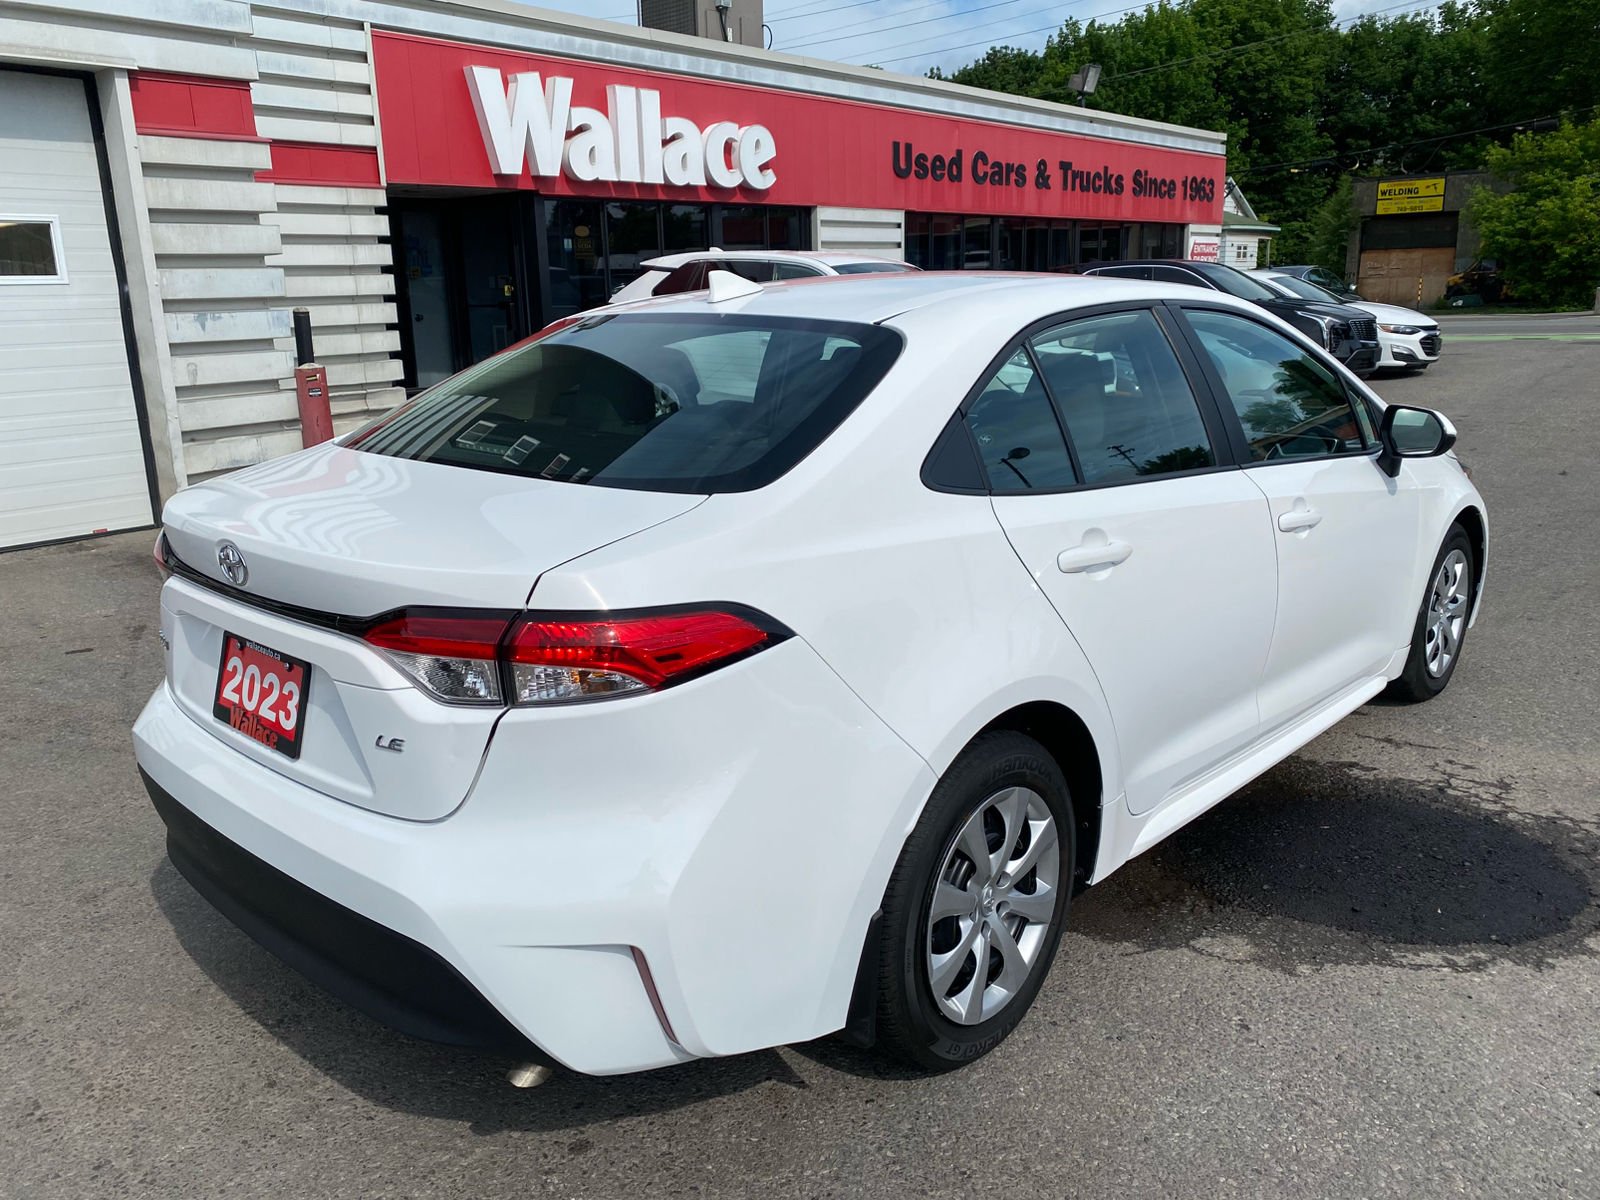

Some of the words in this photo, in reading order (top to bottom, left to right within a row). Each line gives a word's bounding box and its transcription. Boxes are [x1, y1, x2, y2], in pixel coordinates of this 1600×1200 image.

[463, 65, 777, 190] Wallace
[892, 141, 963, 183] Used
[971, 150, 1027, 188] Cars
[1035, 158, 1051, 190] &
[1059, 160, 1124, 196] Trucks
[1132, 168, 1176, 199] Since
[1181, 175, 1215, 203] 1963
[1380, 187, 1419, 197] WELDING
[1193, 244, 1218, 253] ENTRANCE
[245, 640, 281, 661] wallaceauto.ca
[222, 656, 300, 731] 2023
[229, 703, 278, 750] Wallace
[375, 734, 405, 753] LE
